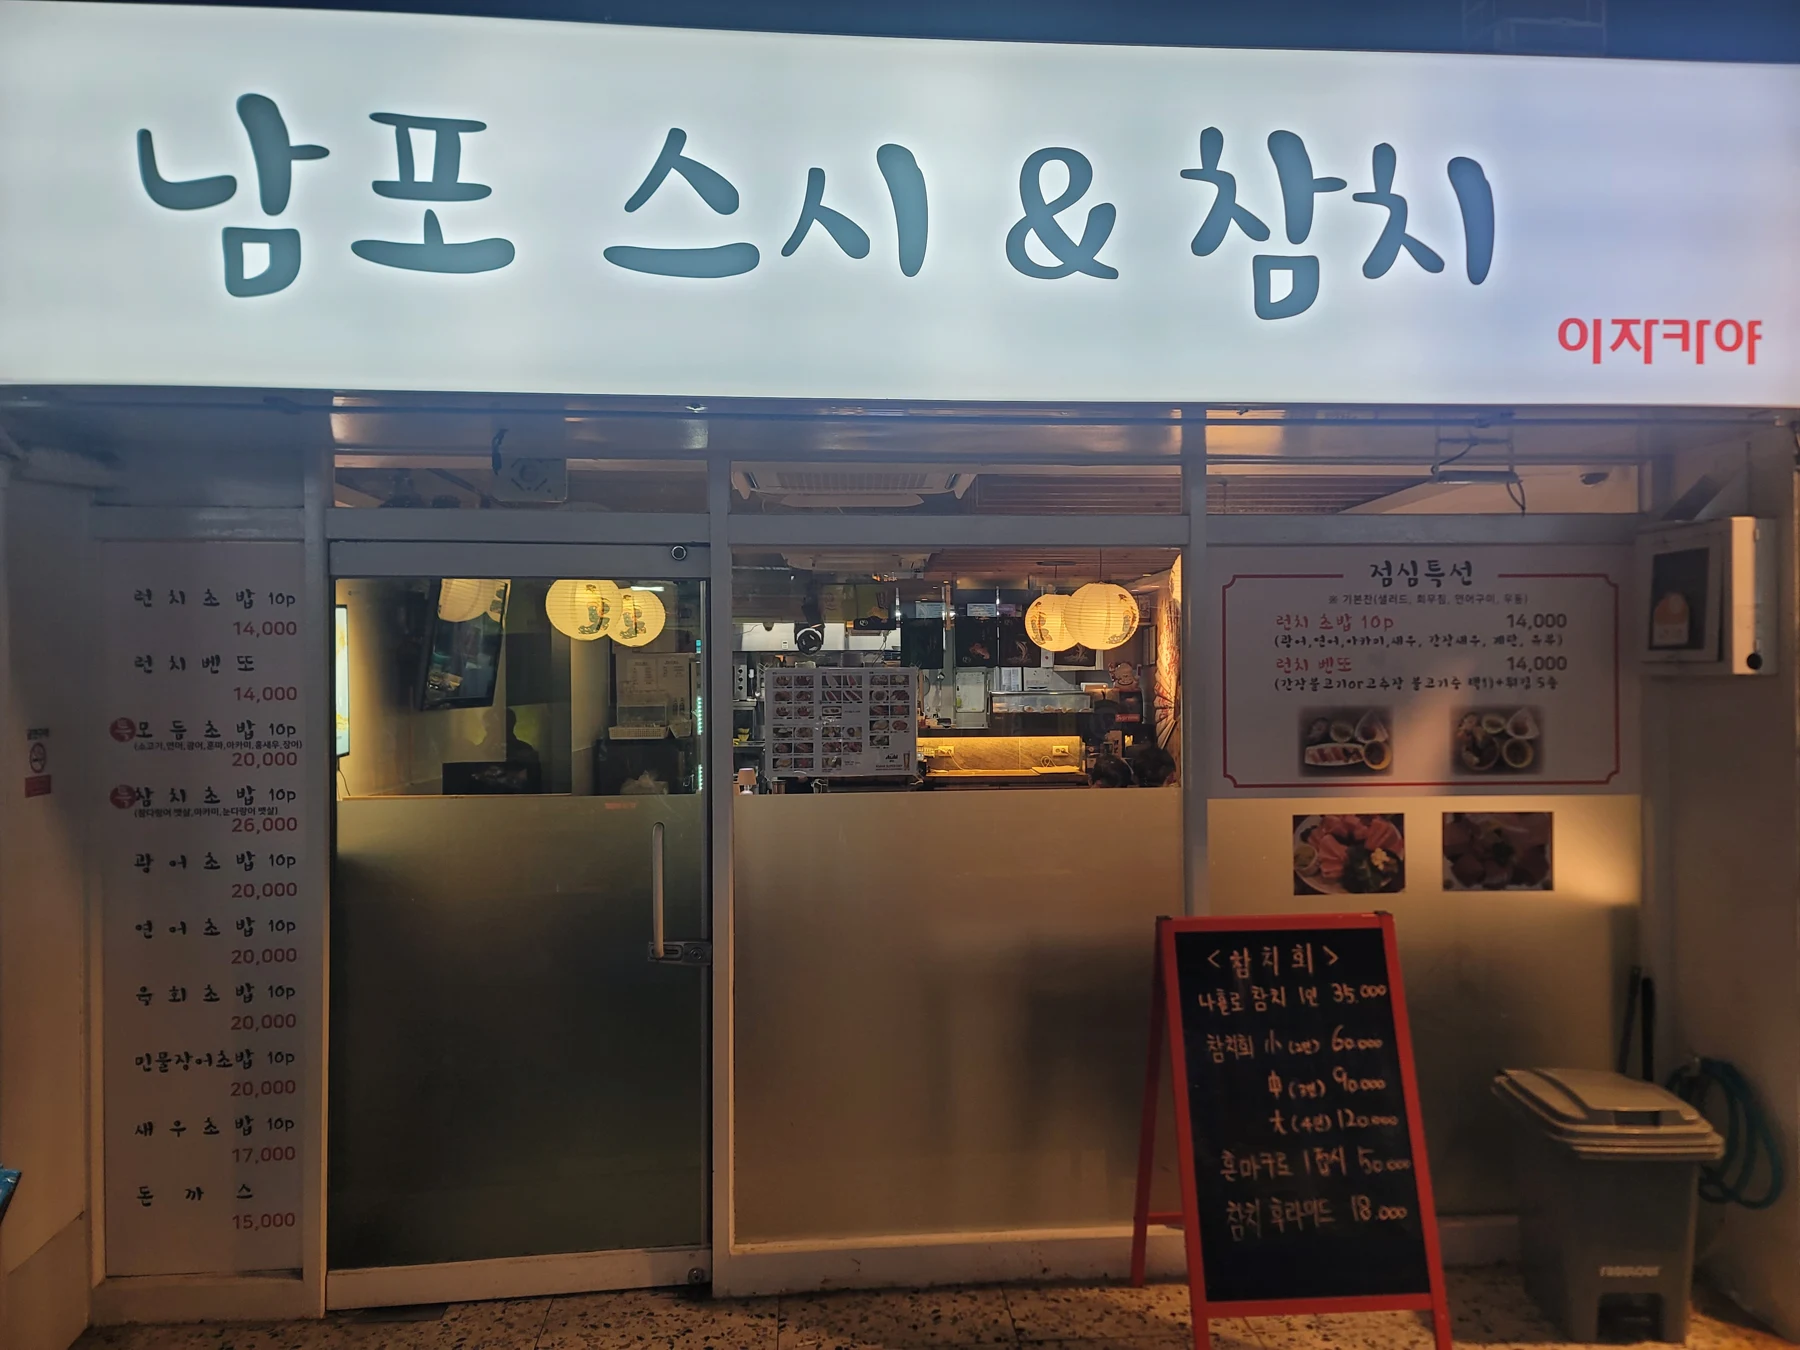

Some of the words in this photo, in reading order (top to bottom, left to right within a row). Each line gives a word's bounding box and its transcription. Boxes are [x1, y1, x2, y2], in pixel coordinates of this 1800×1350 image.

[136, 91, 517, 299] 남포
[602, 126, 929, 279] 스시
[1005, 145, 1120, 281] &
[1179, 125, 1497, 322] 참치
[1557, 316, 1764, 367] 이자카야
[1370, 560, 1473, 588] 점심특선
[268, 592, 296, 607] 10p
[233, 621, 297, 638] 14,000
[1276, 614, 1309, 631] 런치
[1319, 613, 1352, 632] 초밥
[1361, 615, 1394, 632] 10p
[1506, 613, 1567, 630] 14,000
[1276, 657, 1309, 674] 런치
[1318, 656, 1352, 674] 벤또
[1506, 656, 1567, 673] 14,000
[233, 687, 297, 703] 14,000
[269, 723, 297, 738] 10p
[232, 752, 298, 769] 20,000
[269, 788, 297, 803] 10p
[231, 817, 298, 834] 26,000
[269, 854, 296, 869] 10p
[231, 883, 298, 900] 20,000
[268, 919, 296, 935] 10p
[231, 948, 297, 966] 20,000
[268, 985, 296, 1000] 10p
[1250, 985, 1287, 1012] 참치
[230, 1014, 297, 1032] 20,000
[267, 1051, 295, 1066] 10p
[230, 1080, 296, 1099] 20,000
[267, 1117, 295, 1132] 10p
[1268, 1108, 1287, 1135] 大
[231, 1146, 296, 1164] 17,000
[231, 1212, 296, 1231] 15,000
